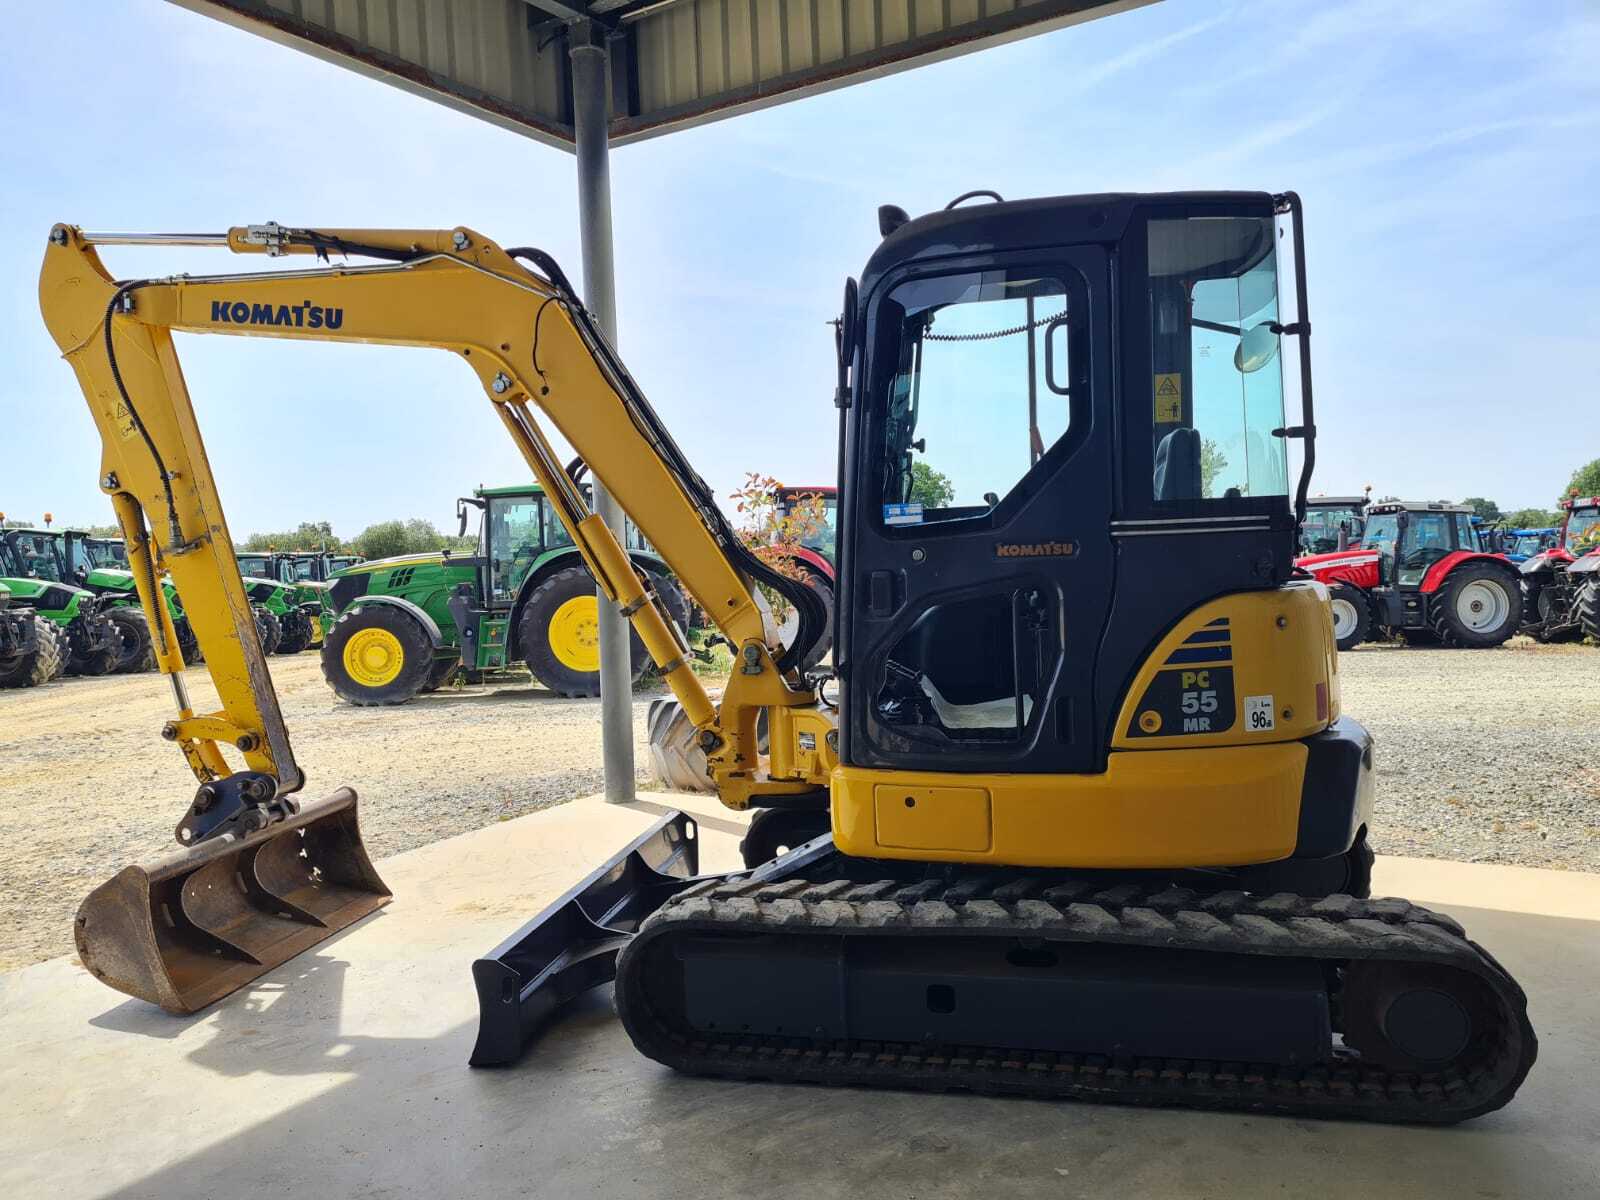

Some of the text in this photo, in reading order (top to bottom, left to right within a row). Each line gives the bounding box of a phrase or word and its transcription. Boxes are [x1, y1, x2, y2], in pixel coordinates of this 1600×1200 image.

[211, 300, 343, 329] KOMATSU
[996, 542, 1073, 556] KOMATSU
[1182, 671, 1210, 688] PC
[1181, 690, 1218, 714] 55
[1184, 717, 1211, 732] MR
[1252, 711, 1266, 729] 96
